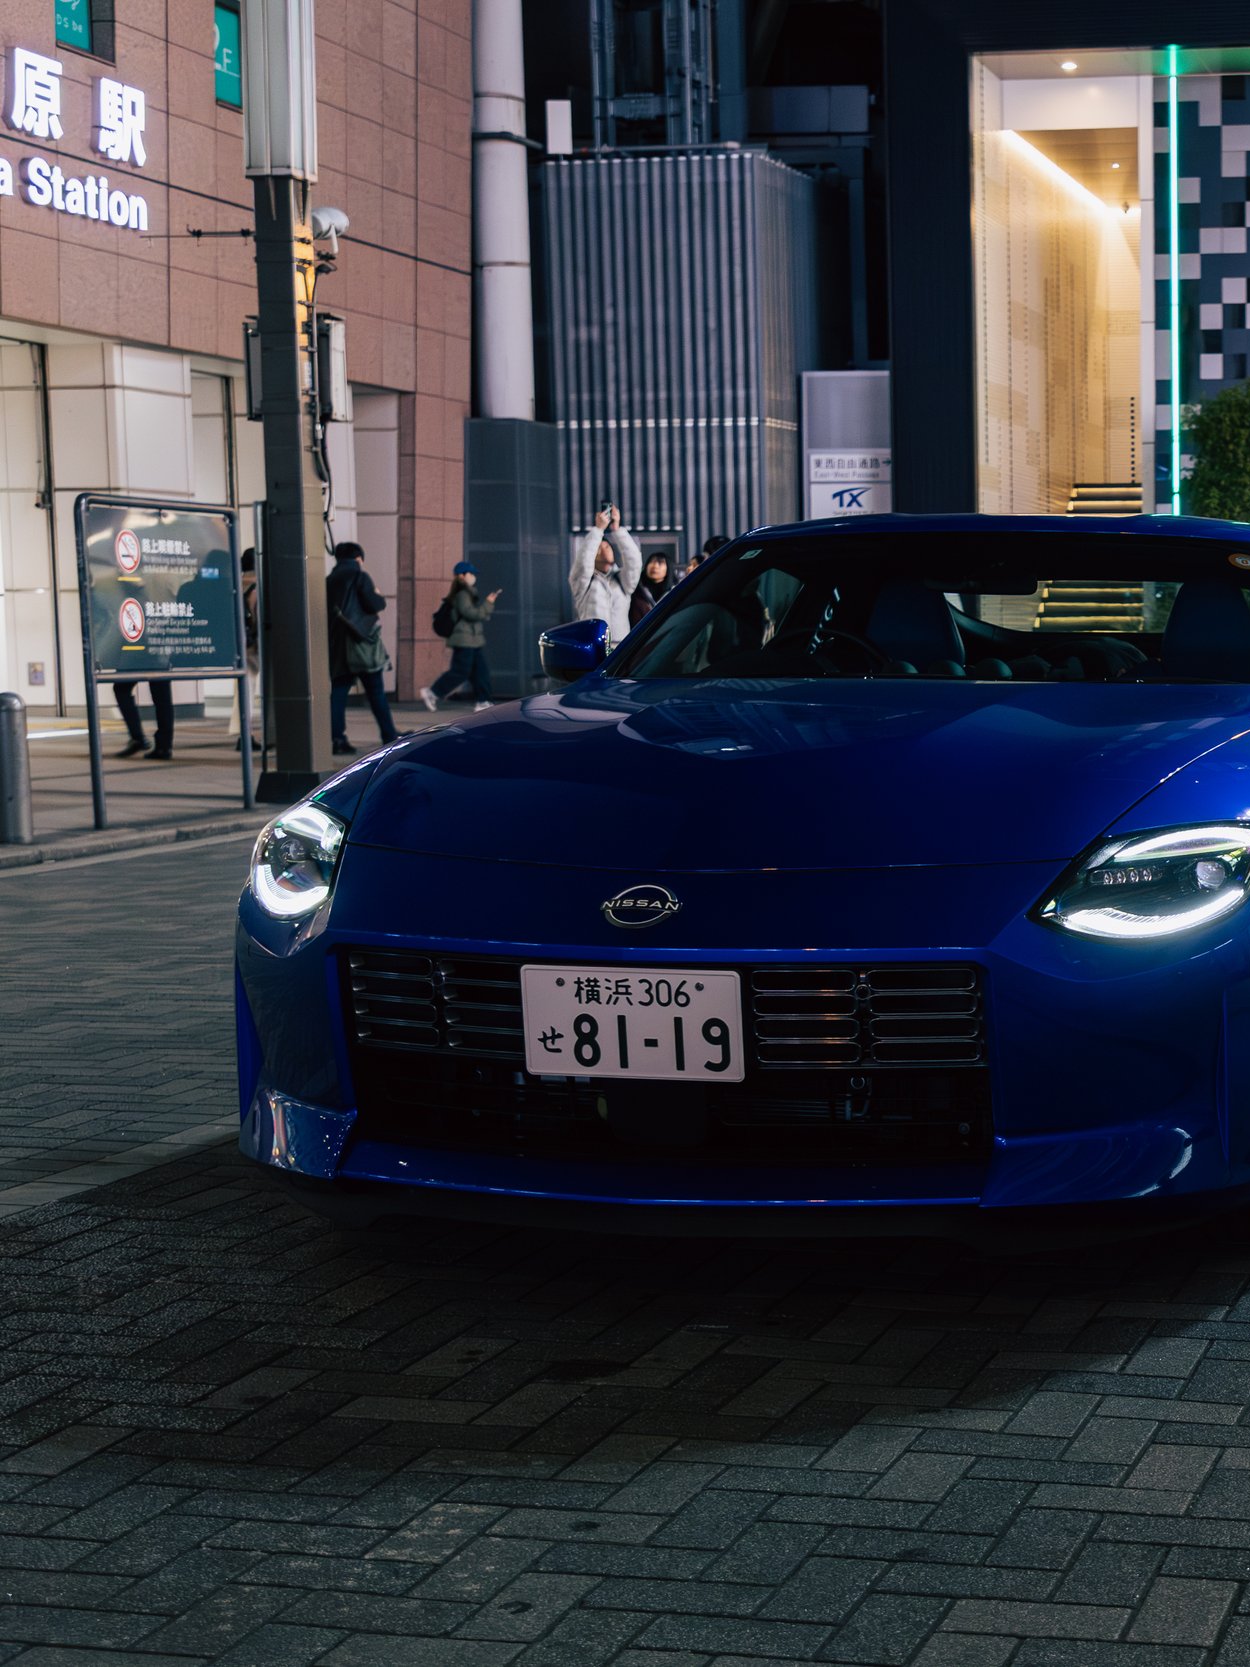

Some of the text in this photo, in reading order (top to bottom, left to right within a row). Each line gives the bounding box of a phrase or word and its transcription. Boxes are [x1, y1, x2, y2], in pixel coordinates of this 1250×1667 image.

[11, 47, 146, 167] 原駅
[28, 157, 148, 231] Station
[832, 487, 872, 508] TX
[602, 900, 679, 910] NISSAN
[537, 1013, 731, 1072] せ 81-19
